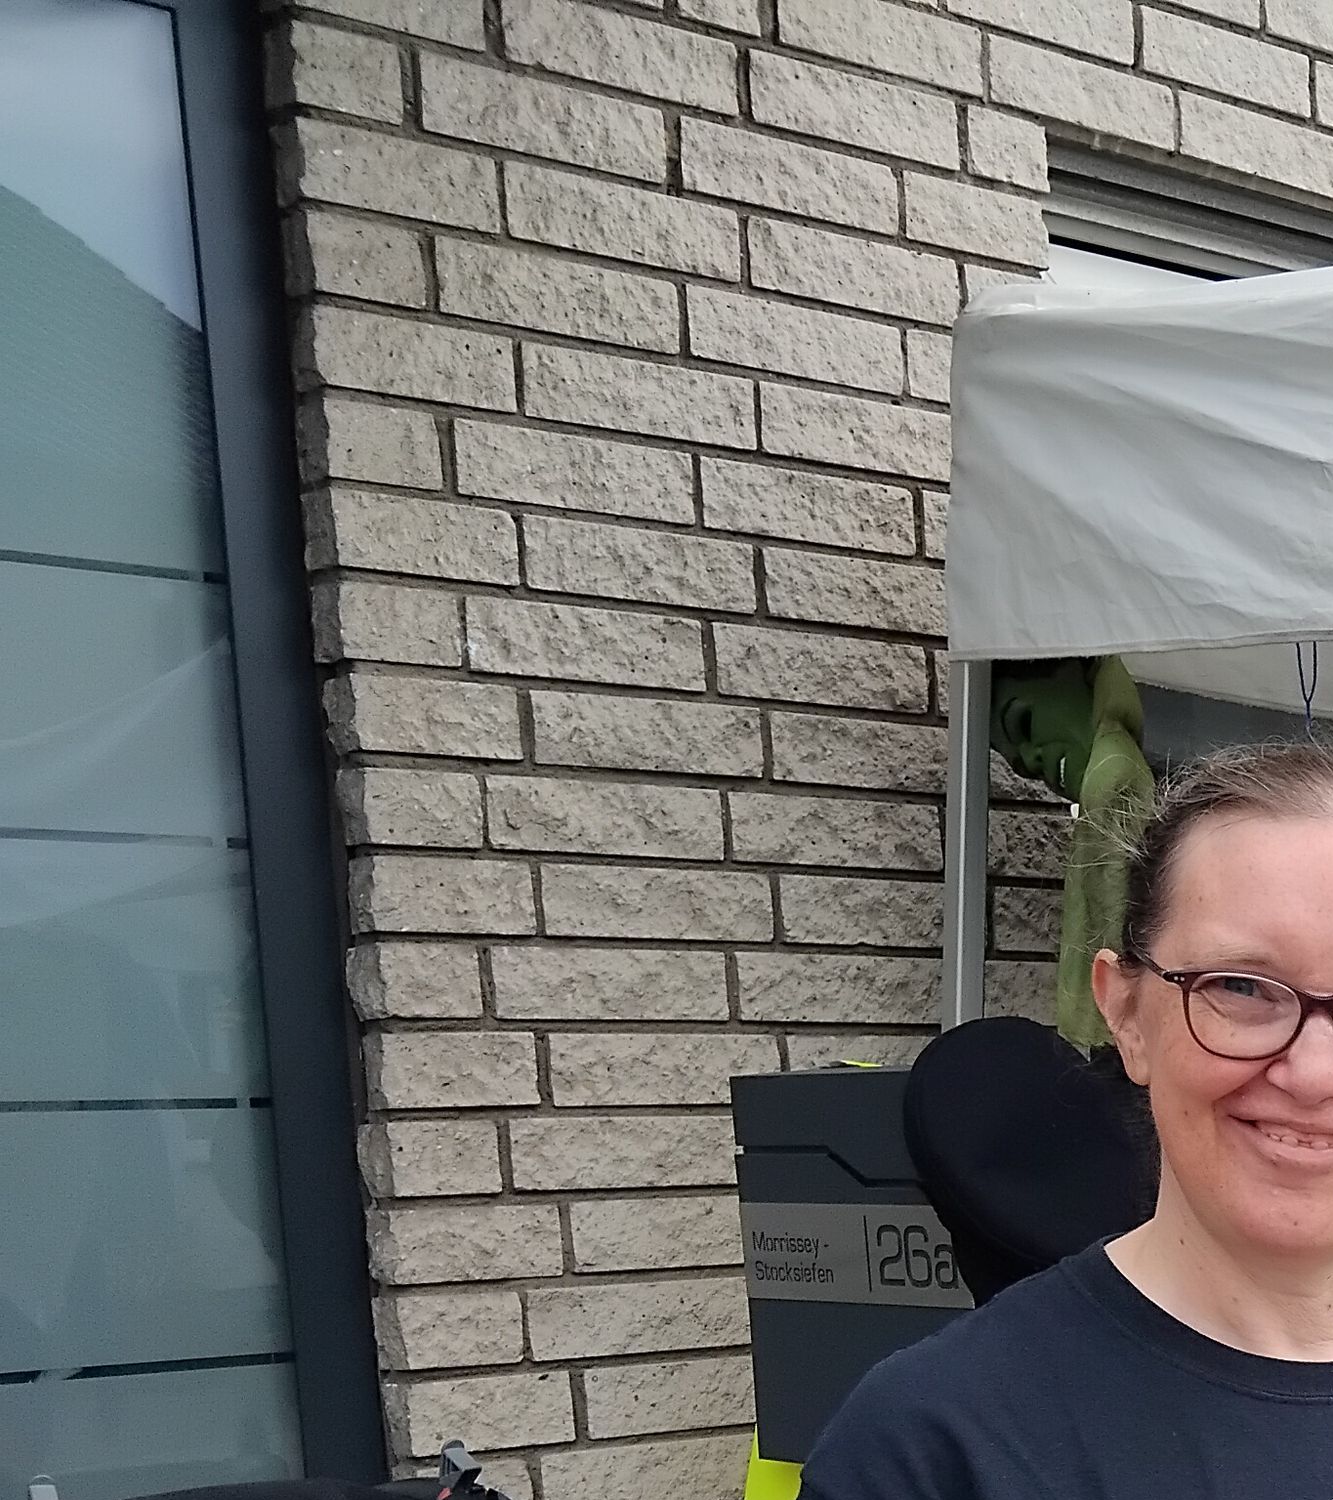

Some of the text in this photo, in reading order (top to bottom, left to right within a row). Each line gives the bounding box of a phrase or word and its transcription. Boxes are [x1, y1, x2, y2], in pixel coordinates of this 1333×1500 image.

[752, 1231, 820, 1259] Morrissey
[876, 1224, 959, 1290] 26a
[755, 1261, 834, 1284] Stocksiefen
